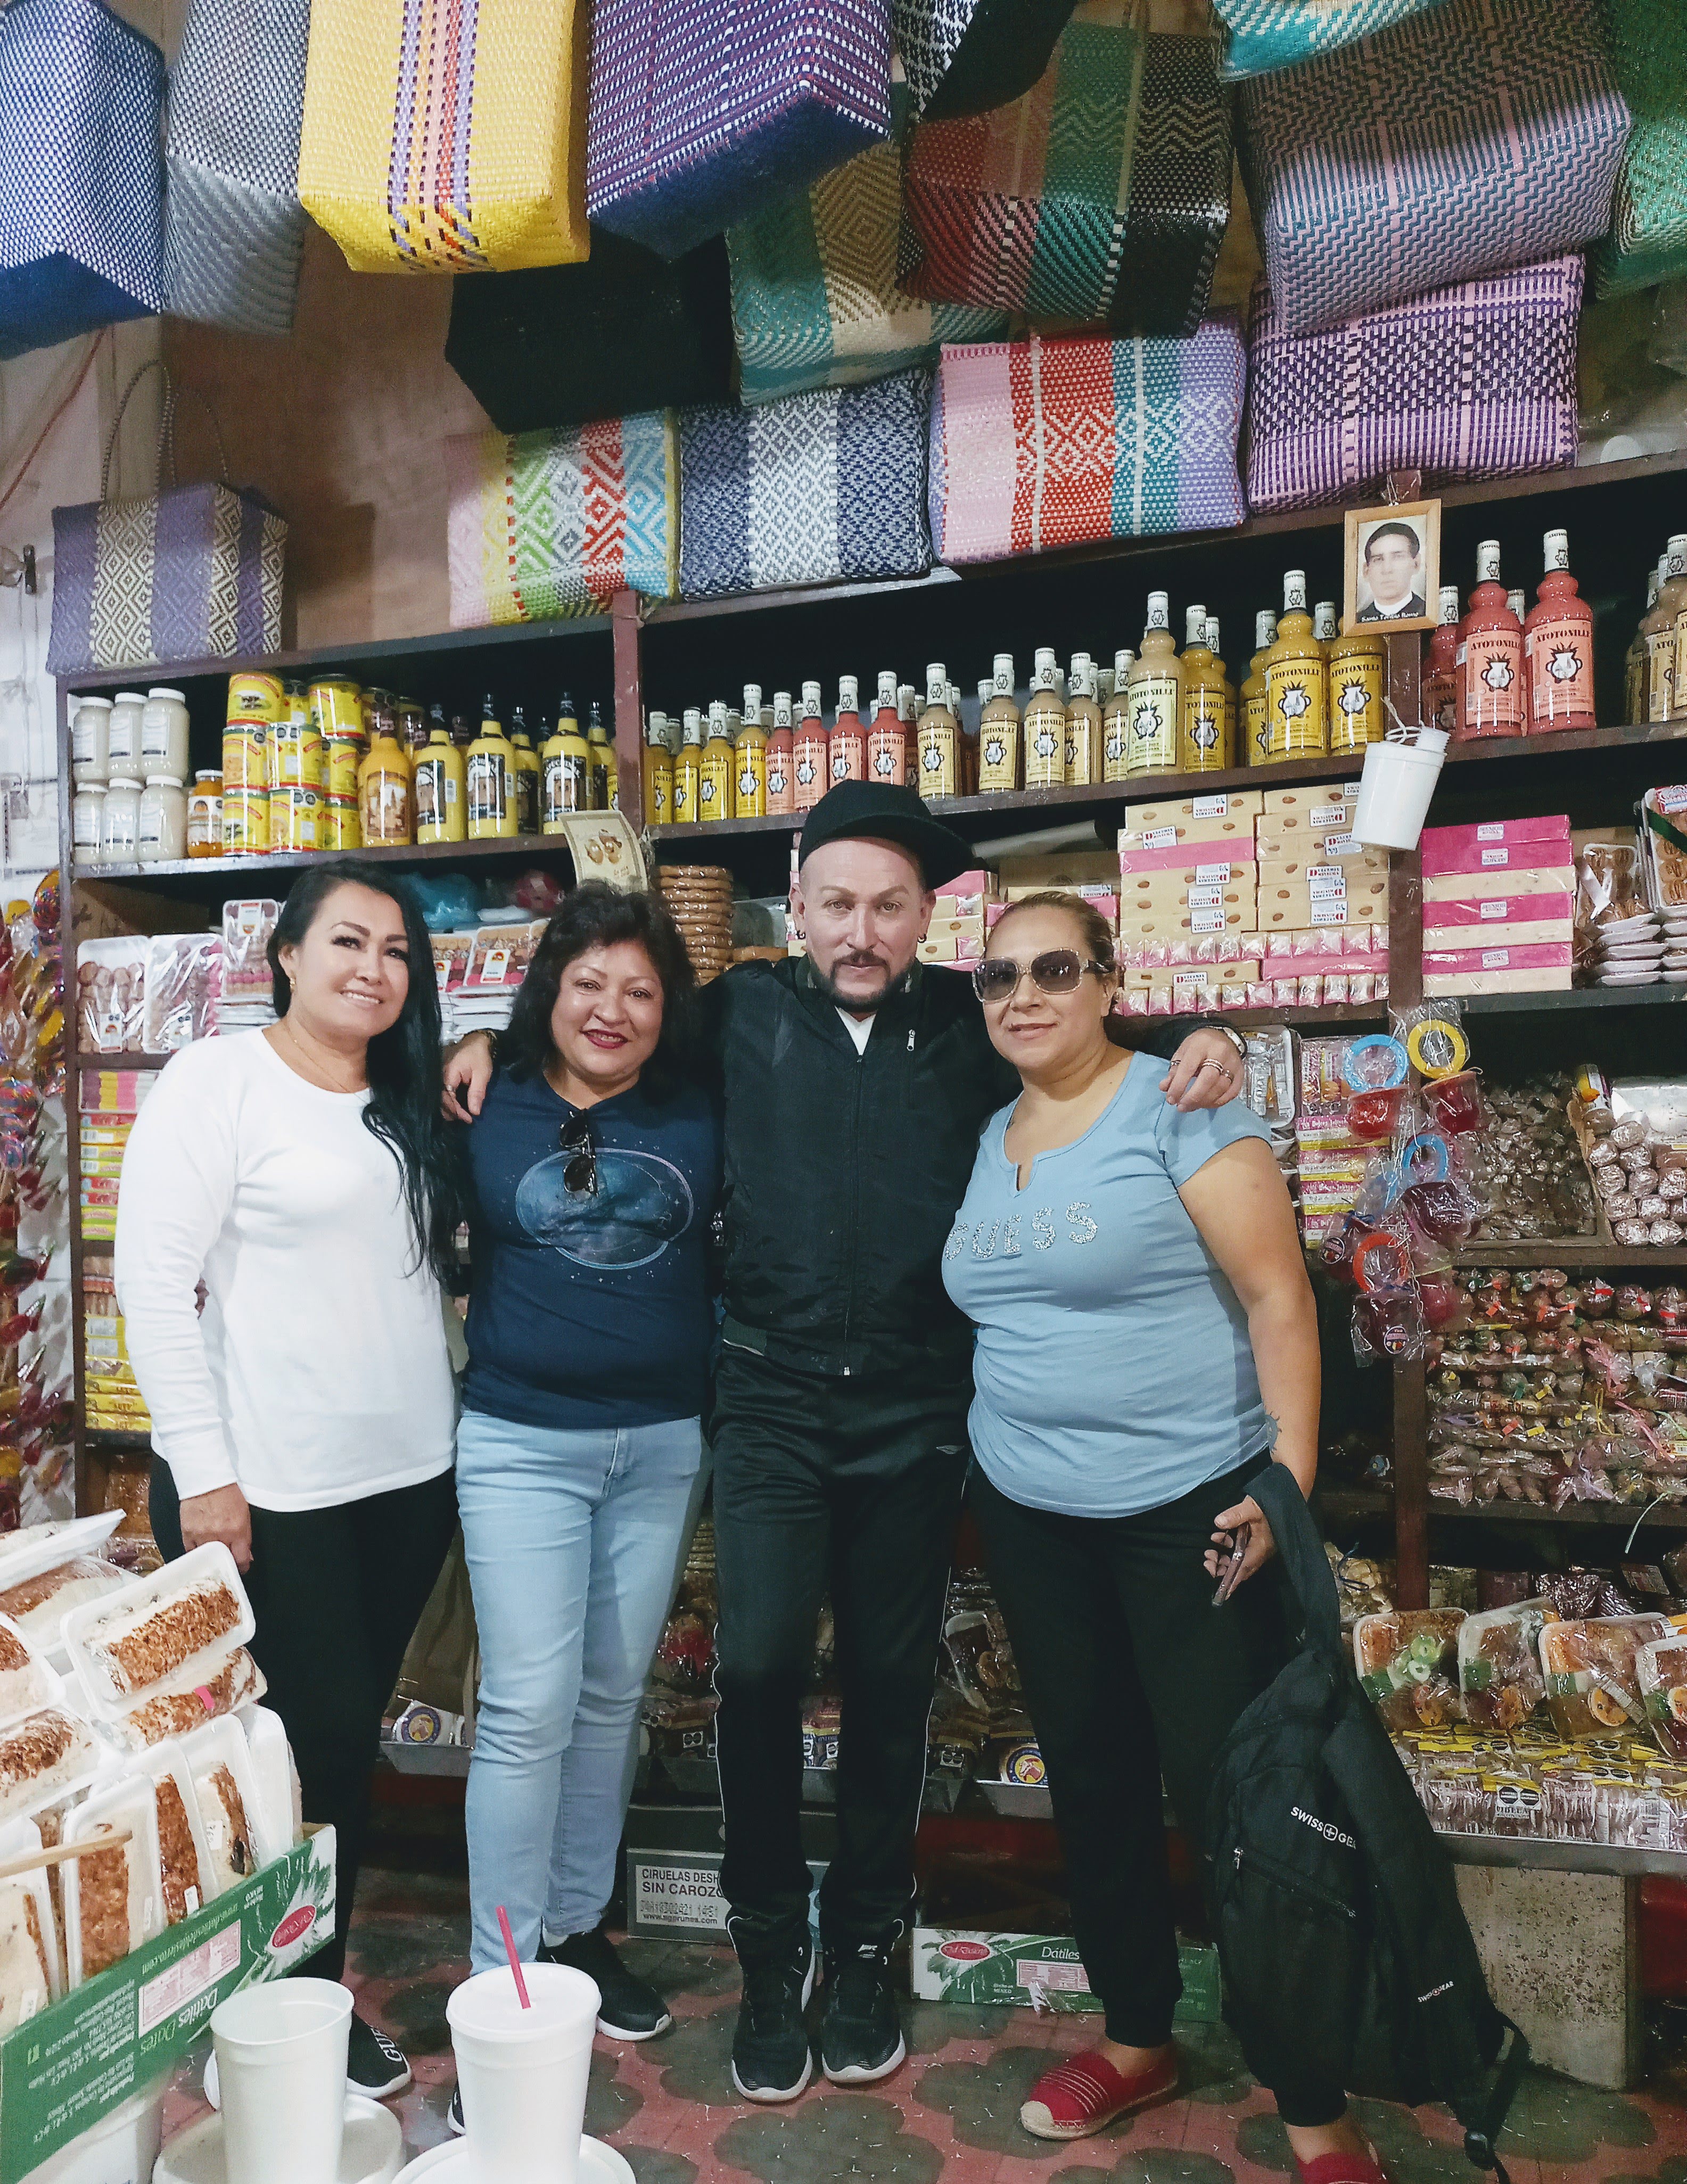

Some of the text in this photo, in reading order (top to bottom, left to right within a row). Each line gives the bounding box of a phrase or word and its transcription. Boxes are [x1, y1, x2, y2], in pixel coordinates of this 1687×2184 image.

[944, 1201, 1098, 1262] GUESS
[1290, 1807, 1324, 1832] SWISS
[641, 1868, 690, 1882] CIRUELAS
[642, 1881, 665, 1893] SIN
[1041, 1946, 1080, 1960] Dátiles
